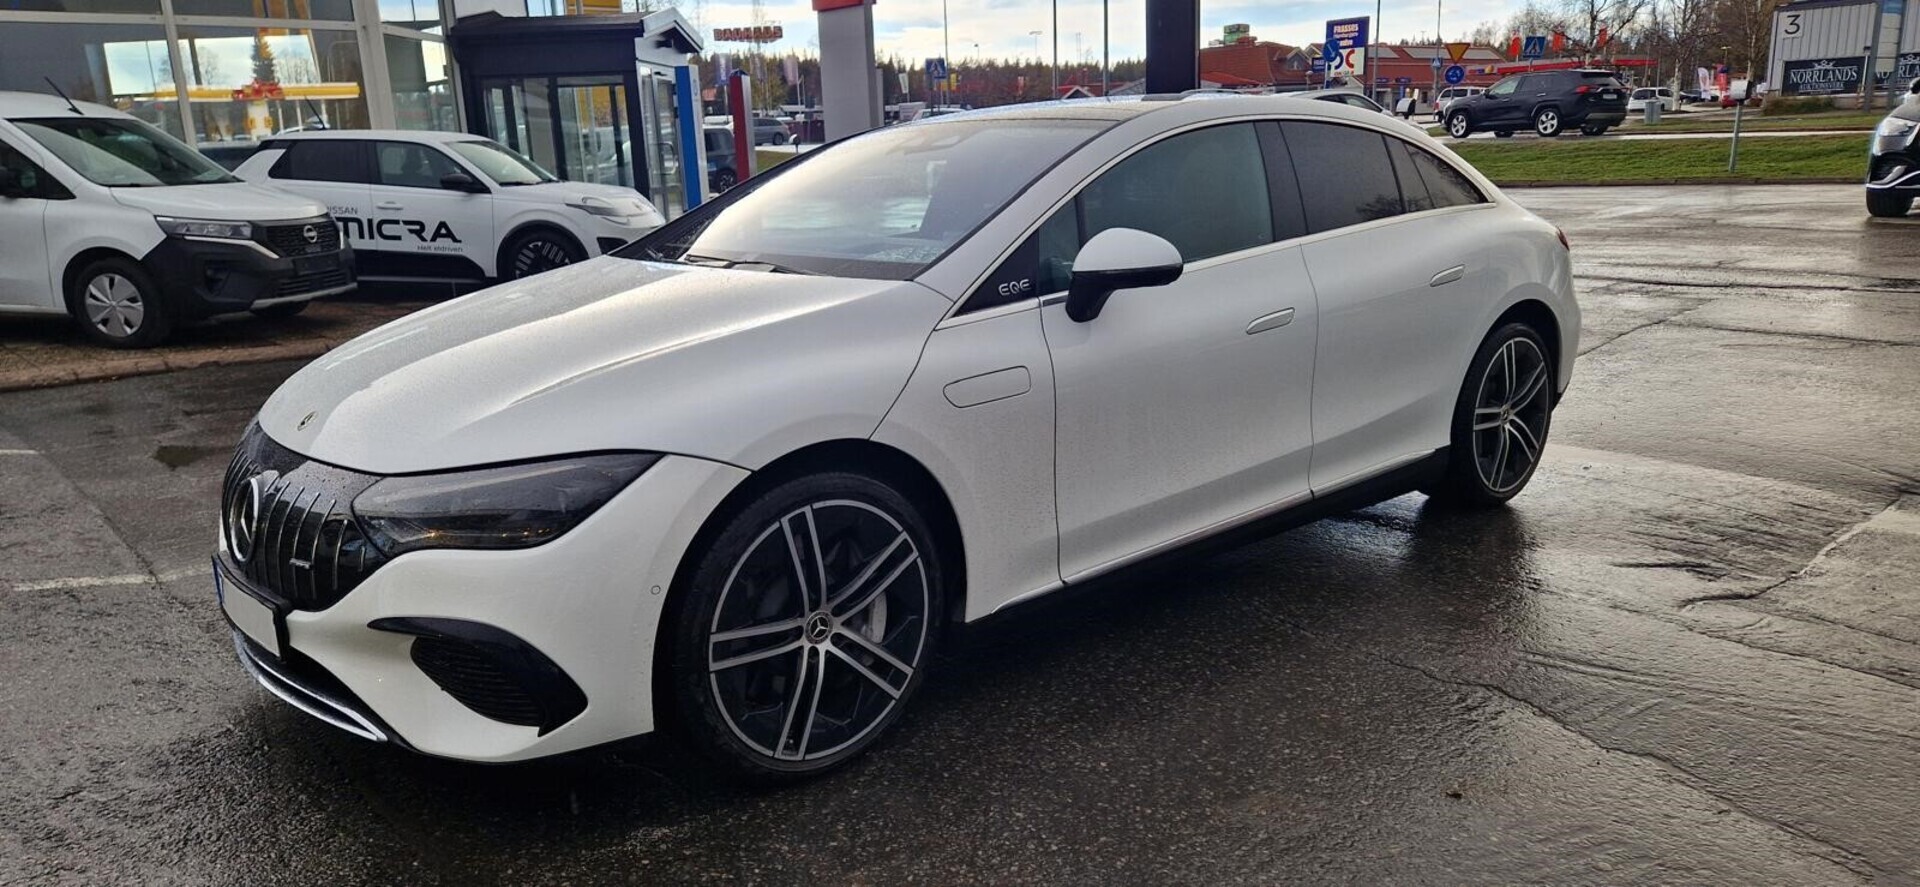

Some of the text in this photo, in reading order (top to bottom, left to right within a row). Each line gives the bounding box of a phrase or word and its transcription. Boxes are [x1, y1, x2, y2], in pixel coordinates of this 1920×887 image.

[1784, 14, 1801, 35] 3
[713, 26, 783, 42] BAUHAUS
[1789, 67, 1858, 84] NORRLANDS
[334, 216, 462, 243] MICRA
[998, 279, 1031, 296] EQE
